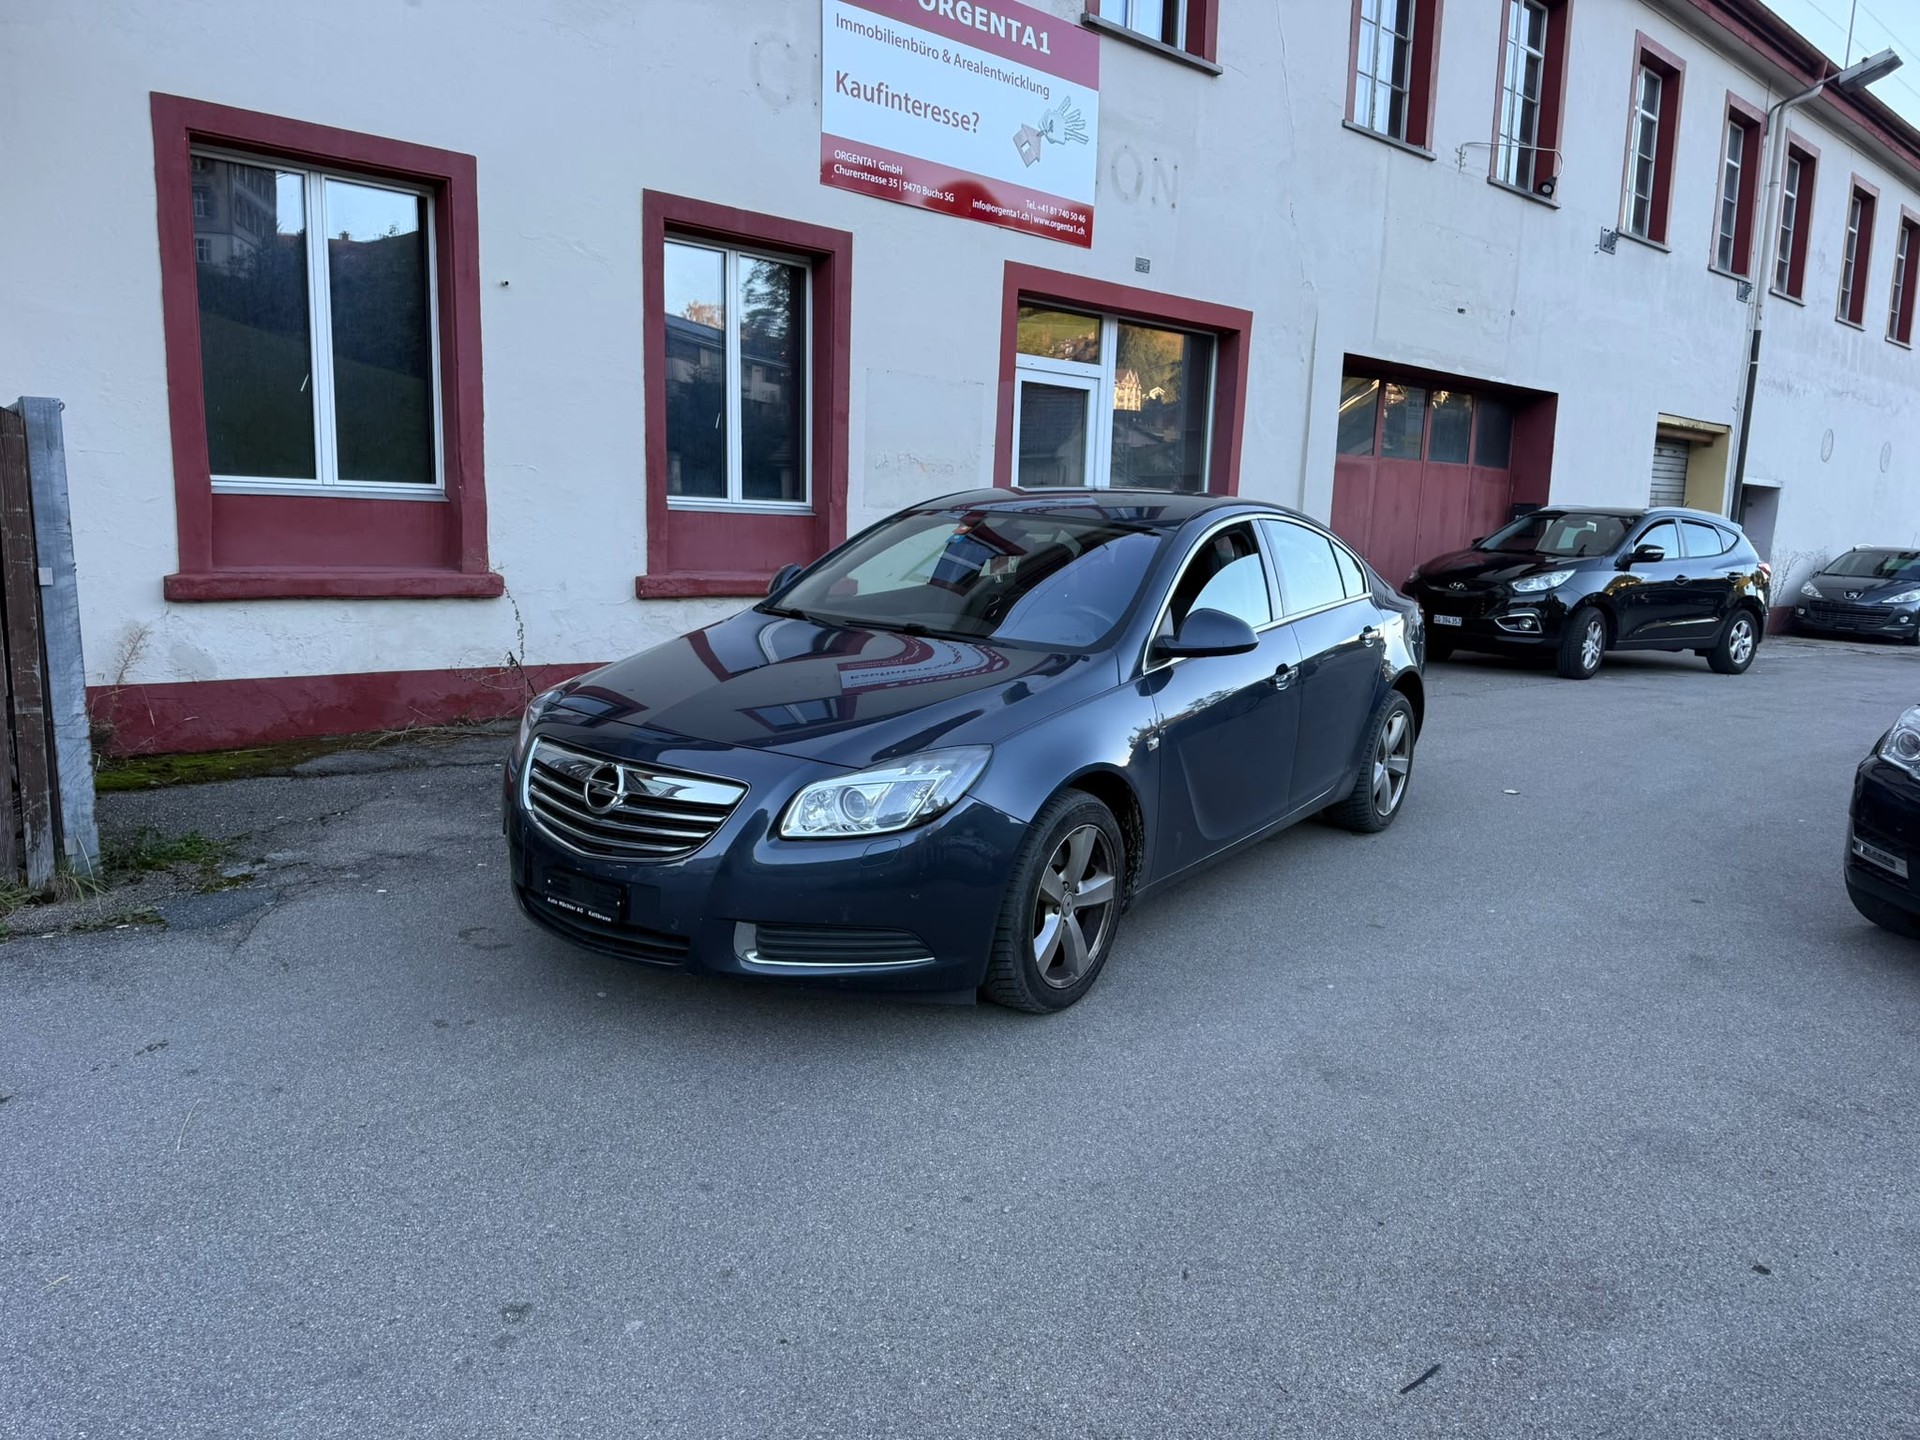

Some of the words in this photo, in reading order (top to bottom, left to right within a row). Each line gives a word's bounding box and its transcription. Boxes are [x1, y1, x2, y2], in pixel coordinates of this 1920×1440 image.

[918, 0, 1050, 54] ORGENTA1
[836, 13, 939, 61] Immobilienbüro
[941, 49, 951, 64] &
[953, 53, 1050, 100] Arealentwicklung
[836, 70, 980, 133] Kaufinteresse?
[834, 149, 877, 168] ORGENTA1
[879, 161, 903, 176] GmbH
[833, 164, 887, 186] Churerstrasse
[888, 177, 898, 188] 35
[903, 181, 921, 194] 9470
[922, 186, 944, 200] Buchs
[944, 191, 955, 202] SG
[972, 198, 1029, 221] info@orgenta1.ch
[1033, 215, 1086, 236] www.orgenta1.ch
[1026, 199, 1037, 211] Tel.
[1049, 206, 1057, 216] 81
[1058, 208, 1069, 219] 740
